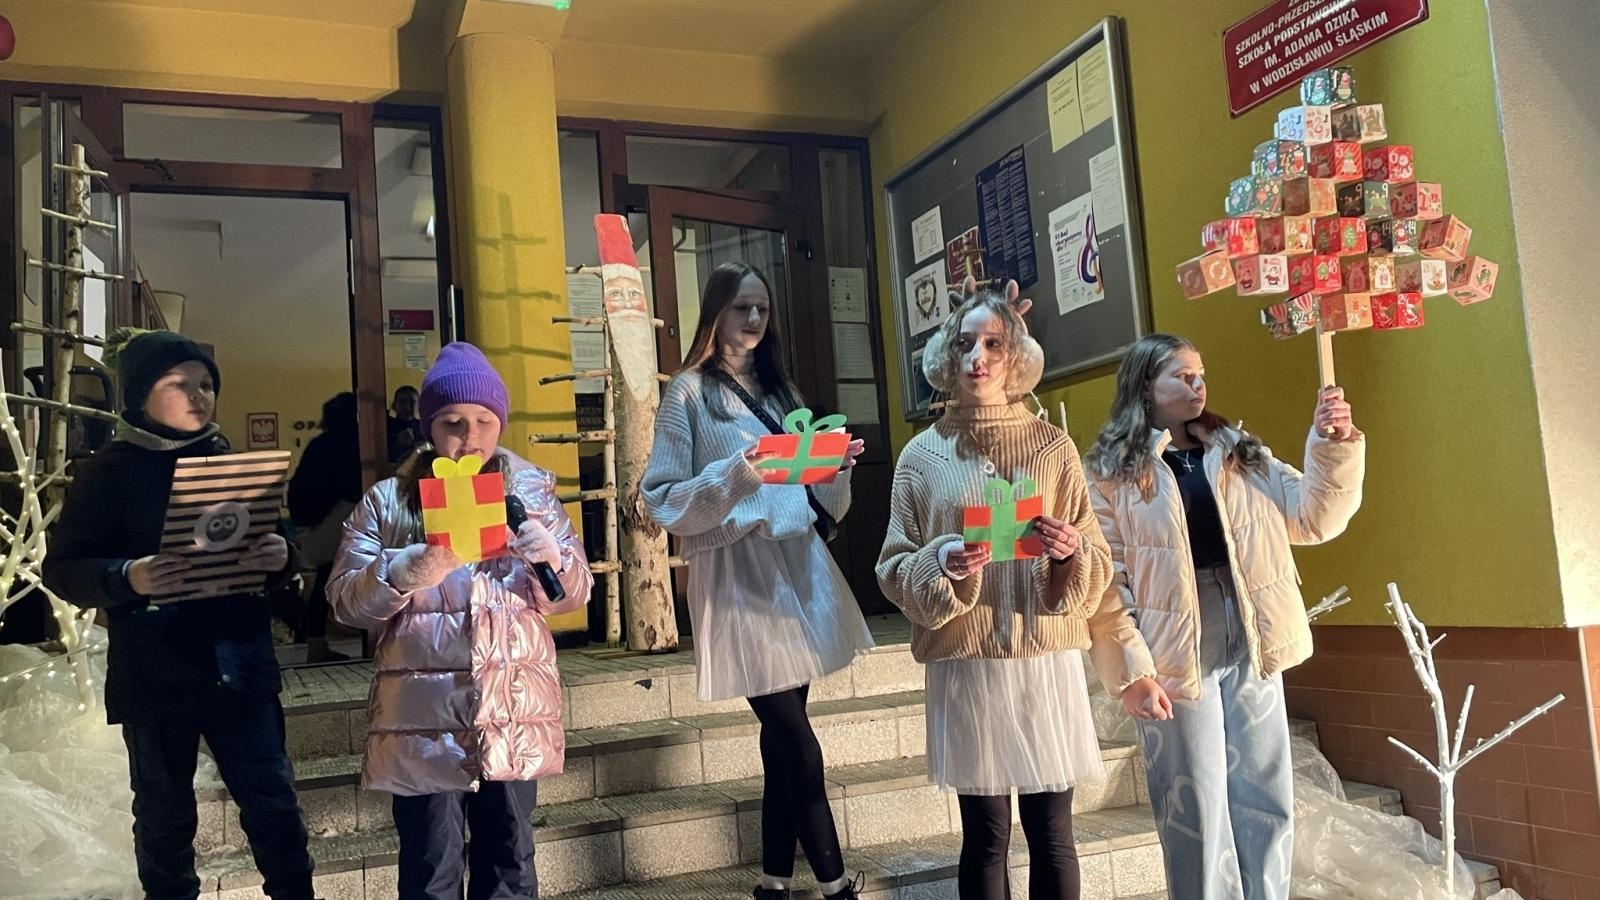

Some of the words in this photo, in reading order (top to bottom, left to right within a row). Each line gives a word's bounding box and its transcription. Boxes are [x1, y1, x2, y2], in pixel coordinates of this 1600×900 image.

[1264, 54, 1282, 69] IM.
[1284, 29, 1323, 57] ADAMA
[1324, 7, 1360, 34] DZIKA
[1238, 44, 1272, 69] SZKOŁA
[1249, 81, 1261, 94] W
[1262, 40, 1334, 87] WODZISŁAWIU
[1335, 11, 1389, 47] ŚLĄSKIM
[1389, 149, 1399, 163] 6
[1354, 183, 1364, 199] 9
[1381, 182, 1389, 197] 9
[1287, 221, 1298, 234] 12
[1407, 219, 1417, 235] 14
[1328, 257, 1340, 274] 18
[1398, 293, 1408, 305] 24
[1292, 312, 1306, 326] 22
[1347, 313, 1360, 326] 23
